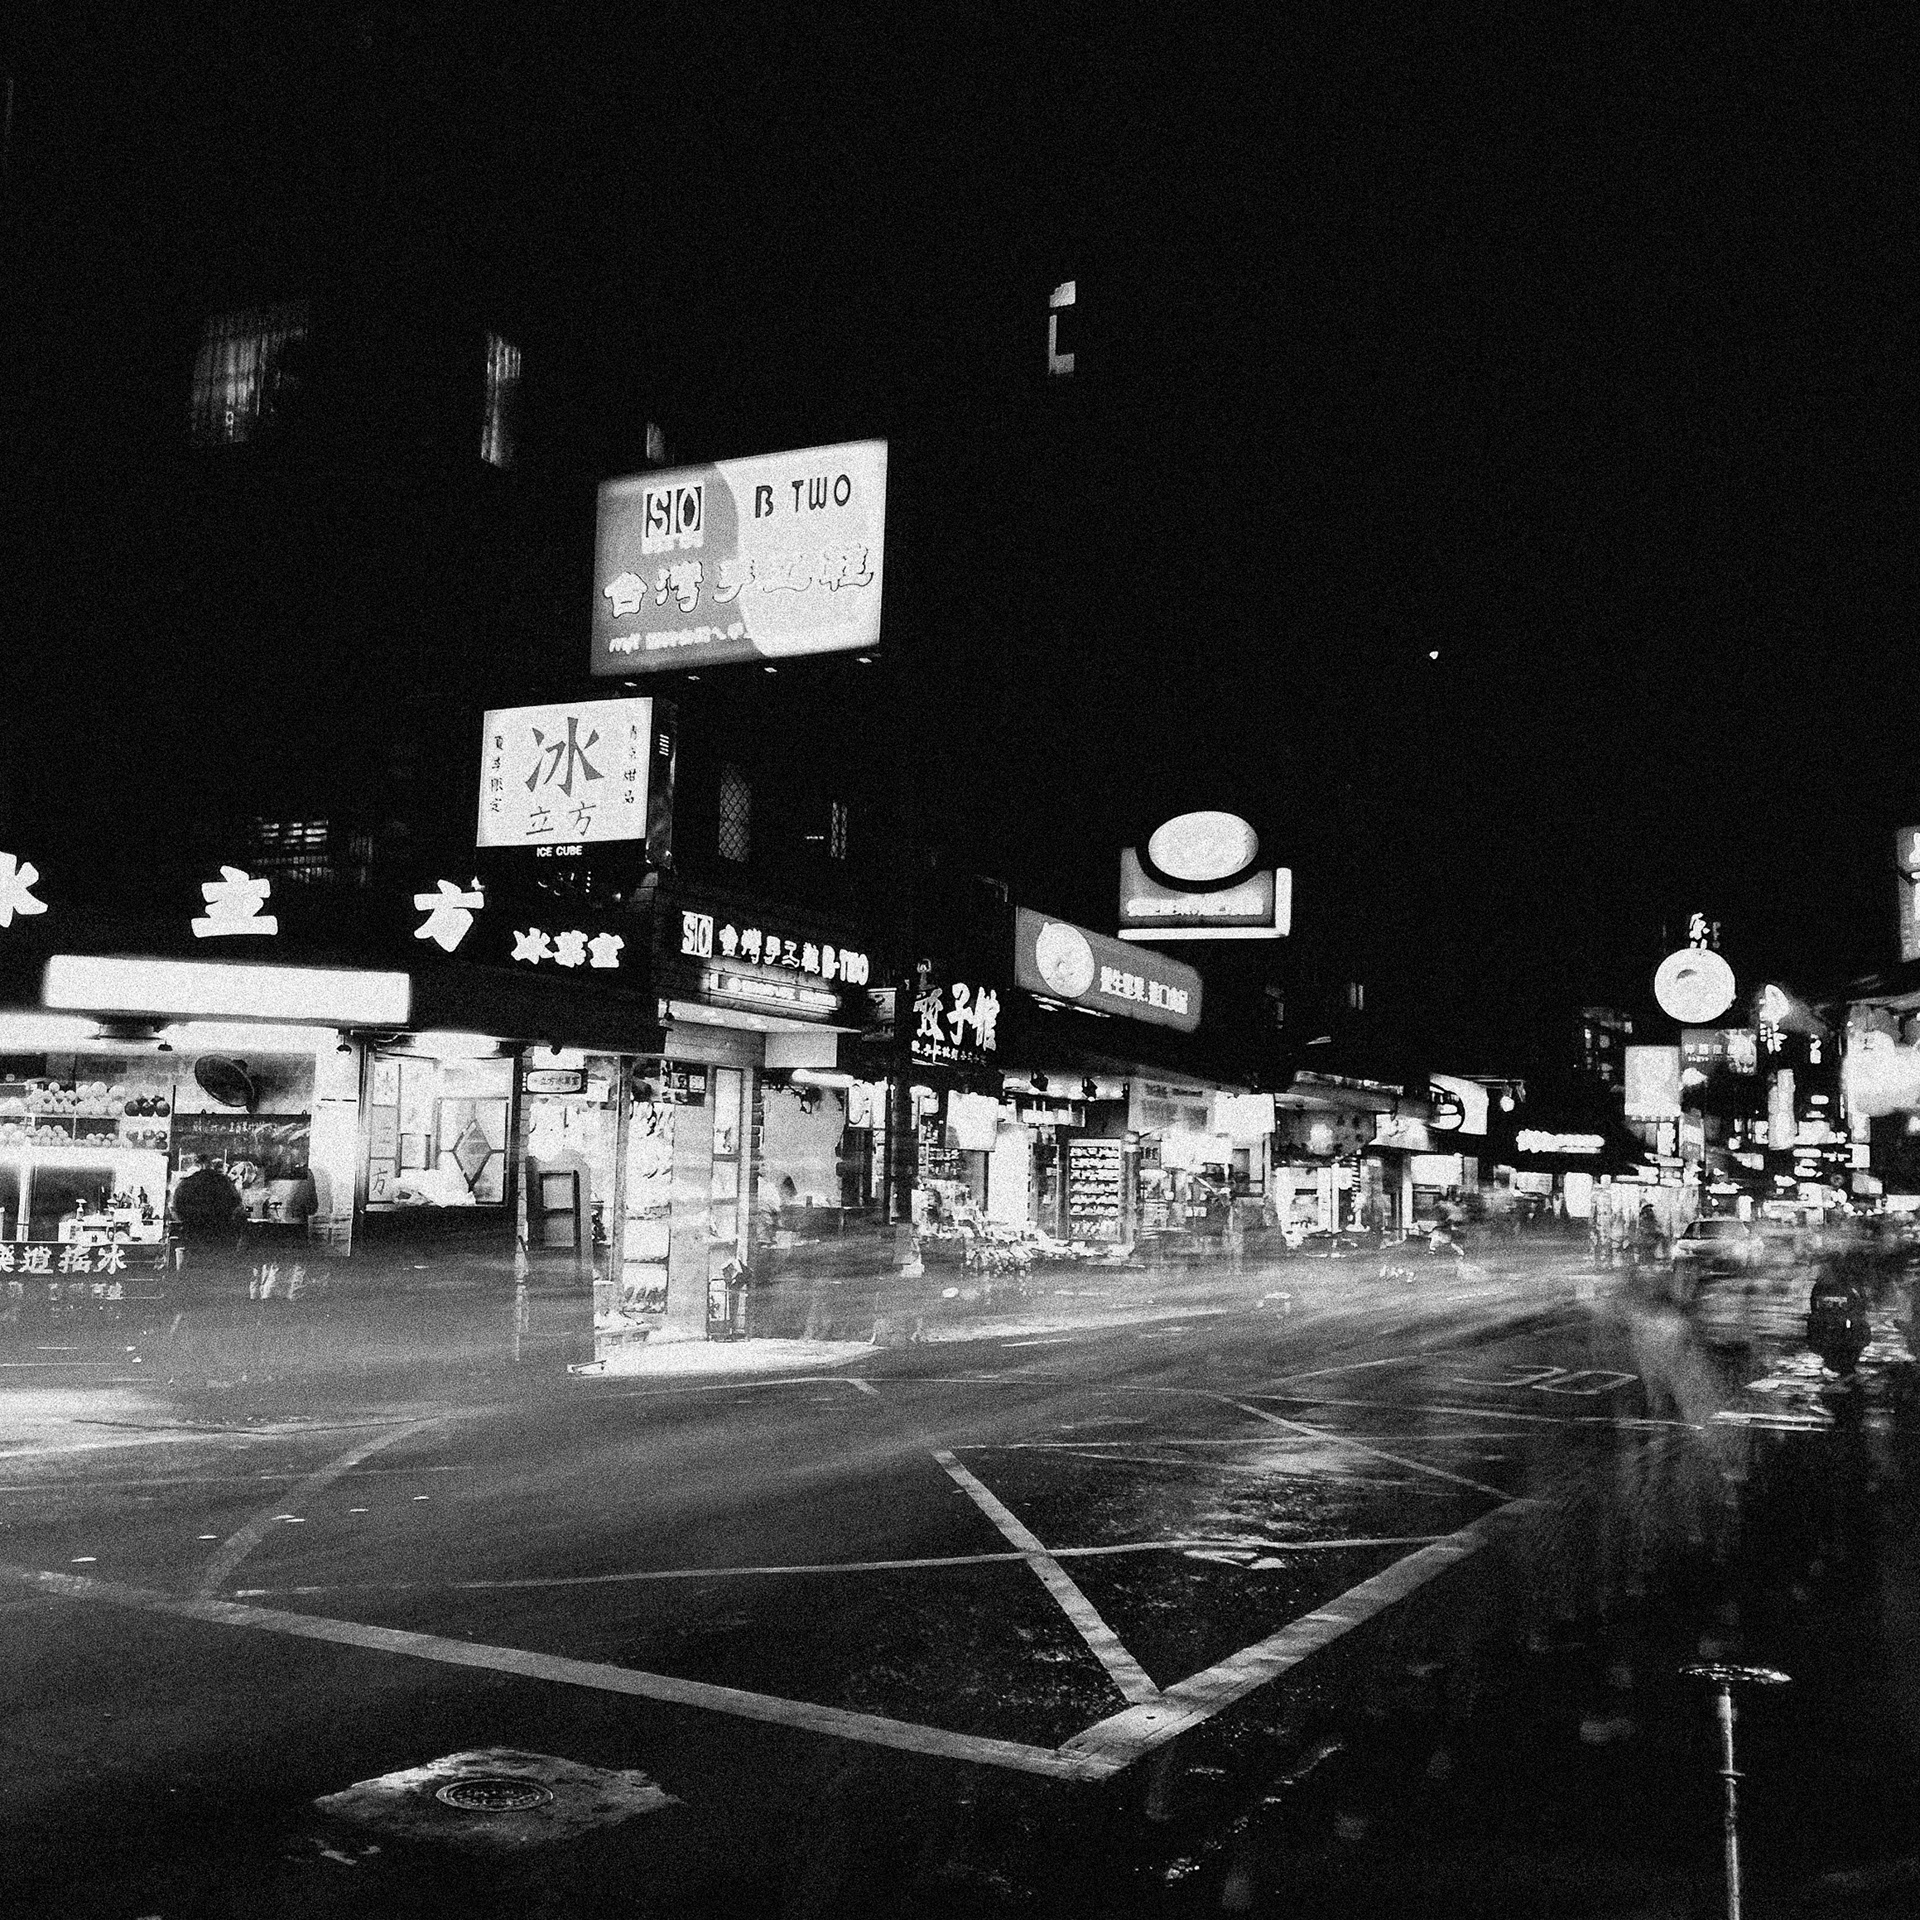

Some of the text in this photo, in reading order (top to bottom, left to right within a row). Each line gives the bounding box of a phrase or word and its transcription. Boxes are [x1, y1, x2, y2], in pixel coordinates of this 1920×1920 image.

[755, 474, 851, 518] B TWO
[524, 716, 605, 798] 冰
[526, 801, 597, 836] 立方
[537, 845, 583, 858] ICE CUBE
